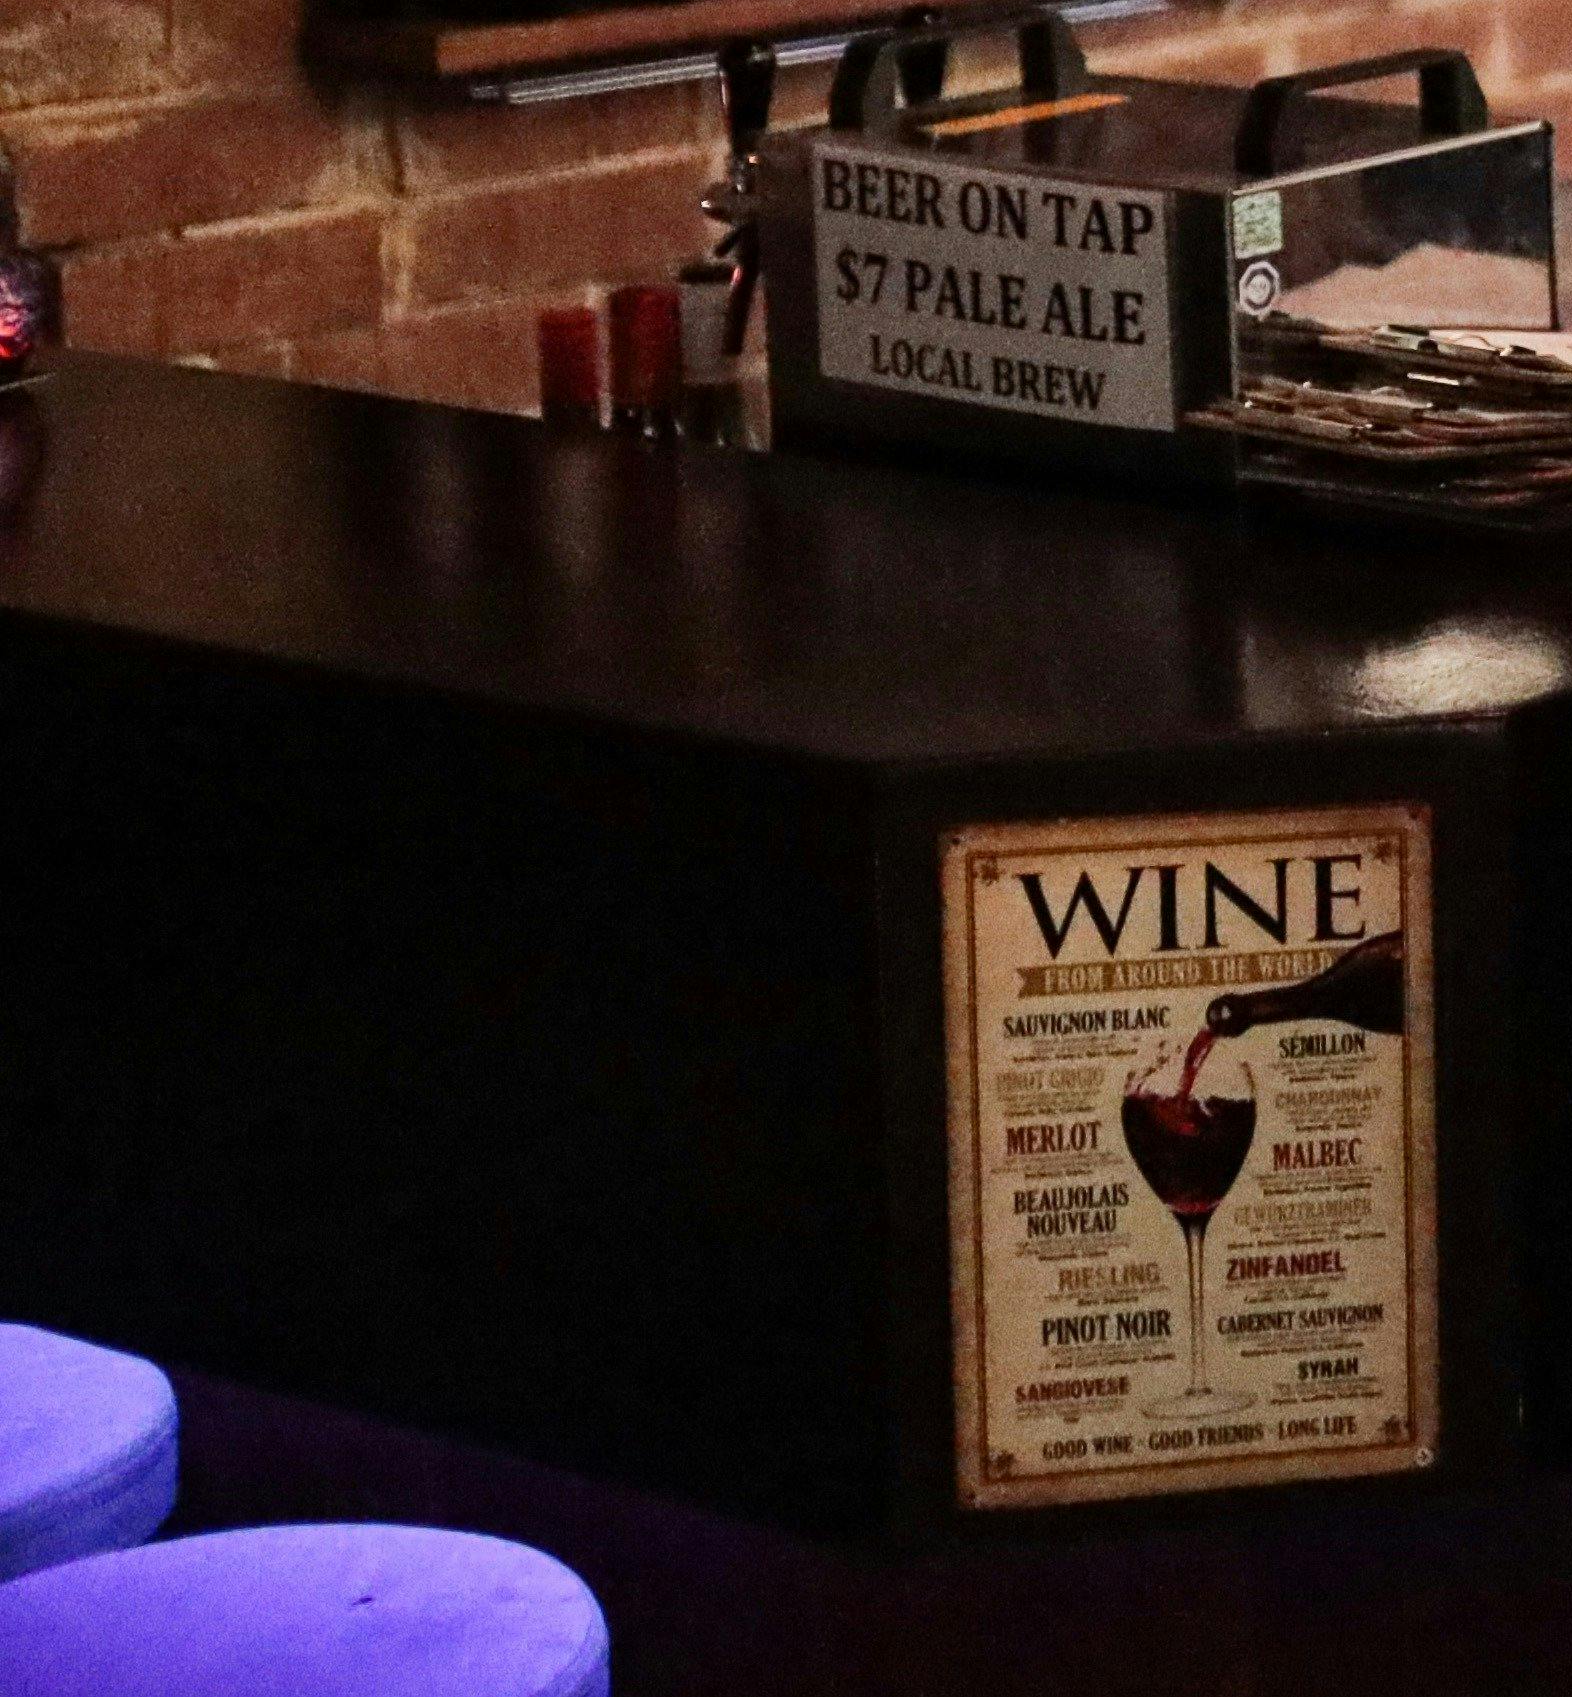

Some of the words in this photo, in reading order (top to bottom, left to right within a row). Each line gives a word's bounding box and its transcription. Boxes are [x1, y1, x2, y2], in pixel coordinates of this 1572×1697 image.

[823, 160, 945, 228] BEER
[958, 181, 1027, 240] ON
[1044, 192, 1153, 255] TAP
[835, 247, 888, 307] $7
[904, 259, 1027, 330] PALE
[1042, 282, 1145, 345] ALE
[868, 334, 982, 393] LOCAL
[992, 357, 1105, 410] BREW
[1016, 854, 1367, 959] WINE
[1043, 965, 1103, 994] FROM
[1113, 959, 1201, 988] AROUND
[1210, 958, 1244, 983] THE
[1260, 948, 1336, 979] WORLD
[1003, 1009, 1107, 1040] SAUVIGNON
[1112, 1005, 1172, 1033] BLANC
[1006, 1119, 1102, 1156] MERLOT
[1273, 1137, 1363, 1171] MALBEC
[1014, 1182, 1130, 1215] BEAUJOLAIS
[1027, 1210, 1118, 1238] NOUVEAU
[1058, 1263, 1161, 1292] RIESLING
[1227, 1249, 1347, 1282] ZINFANDEL
[1042, 1312, 1109, 1346] PINOT
[1116, 1309, 1172, 1341] NOIR
[1216, 1310, 1296, 1335] CABERNET
[1299, 1303, 1384, 1328] SAUVIGNON
[1298, 1357, 1360, 1380] SYRAH
[1015, 1376, 1131, 1404] SANGIOVESE
[1042, 1439, 1087, 1461] GOOD
[1093, 1435, 1132, 1456] WINE
[1148, 1429, 1193, 1451] GOOD
[1198, 1422, 1264, 1446] FRIENDS
[1277, 1418, 1320, 1440] LONG
[1323, 1415, 1358, 1436] LIFE
